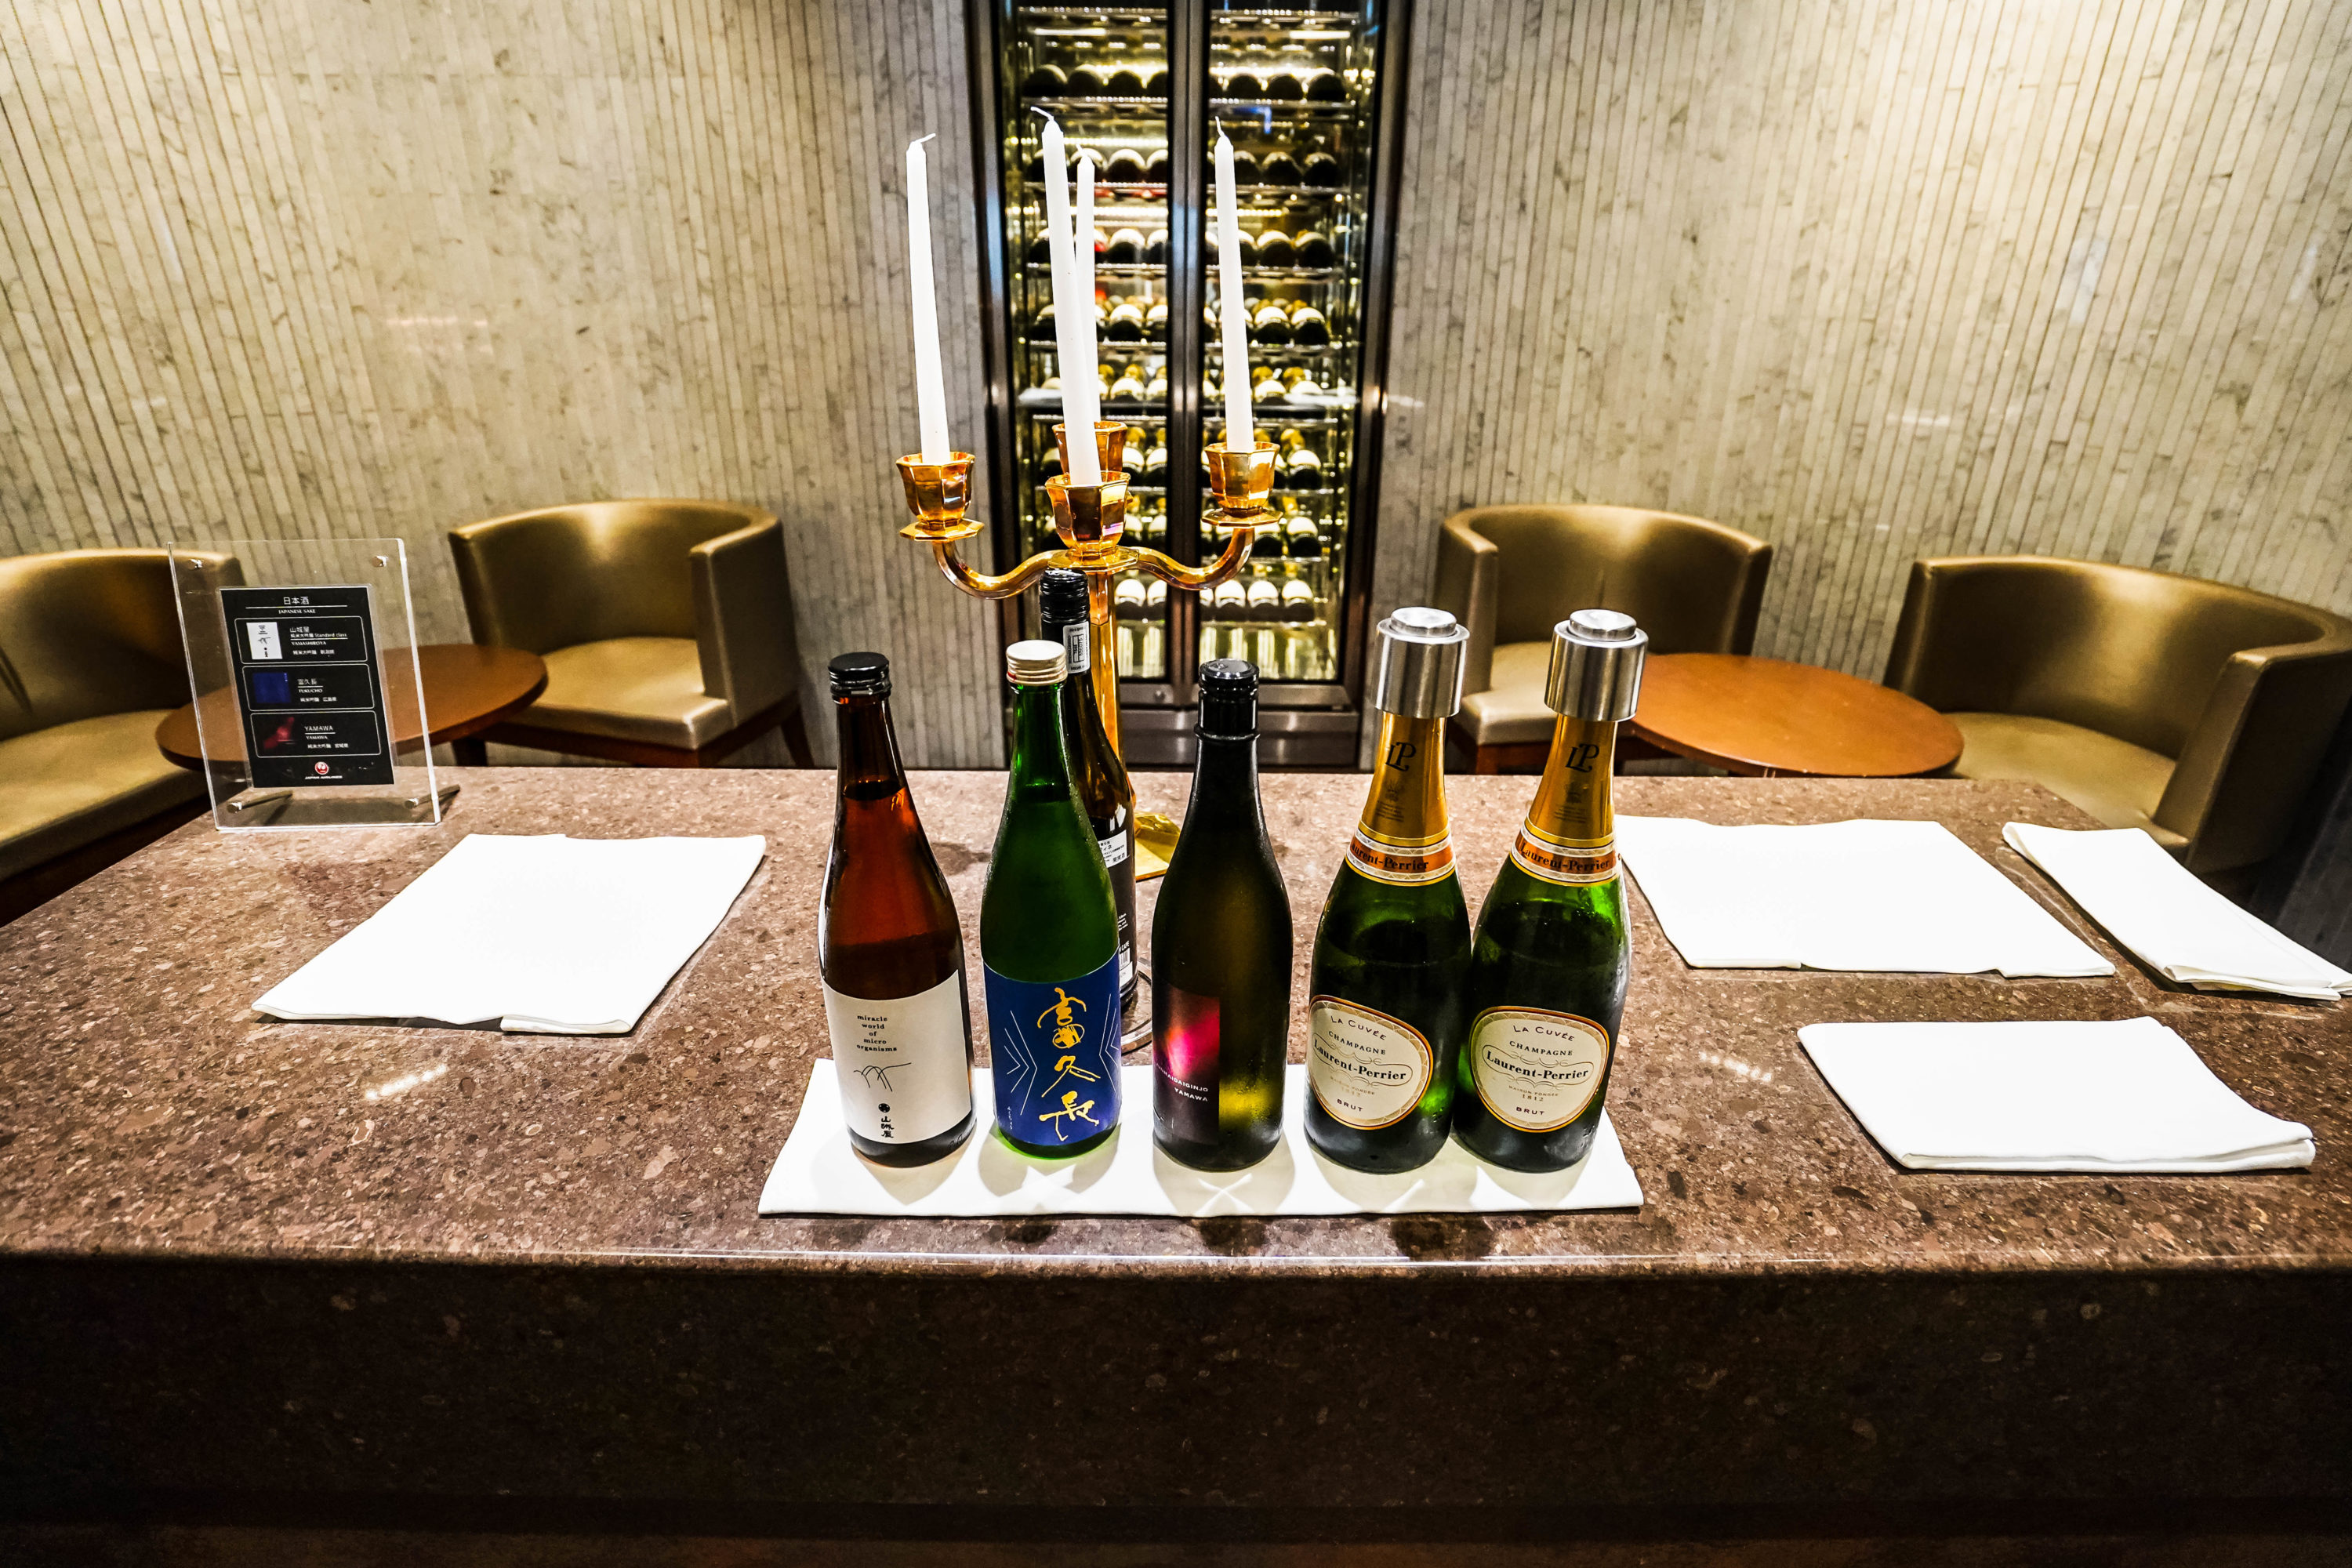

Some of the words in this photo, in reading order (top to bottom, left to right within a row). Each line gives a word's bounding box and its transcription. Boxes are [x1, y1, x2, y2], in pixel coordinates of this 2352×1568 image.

[283, 597, 309, 605] 日本酒
[1520, 841, 1610, 871] Laurent-Perrier
[1330, 1015, 1344, 1025] LA
[1328, 1030, 1386, 1055] CHAMPAGNE
[1509, 1040, 1573, 1056] CHAMPAGNE
[1314, 1039, 1406, 1080] Laurent-Perrier
[1486, 1051, 1589, 1081] Laurent-Perrier
[1174, 1087, 1208, 1102] YAMAWA
[1522, 1093, 1544, 1102] 1812
[1337, 1098, 1363, 1112] BRUT
[1515, 1106, 1545, 1116] BRUT
